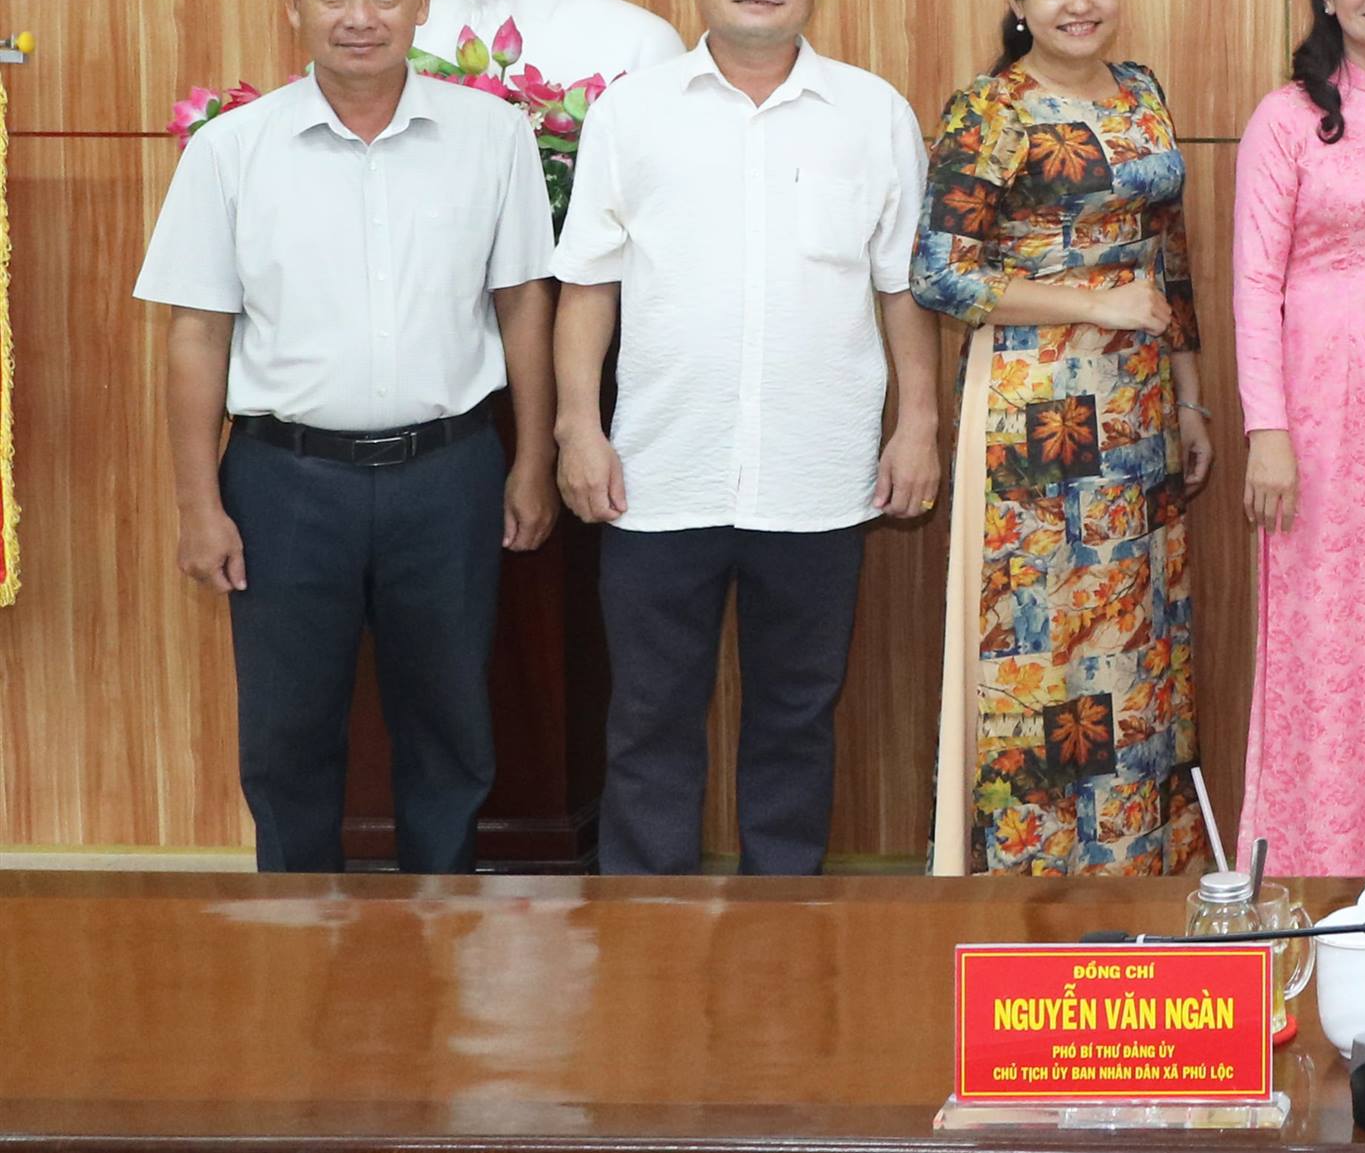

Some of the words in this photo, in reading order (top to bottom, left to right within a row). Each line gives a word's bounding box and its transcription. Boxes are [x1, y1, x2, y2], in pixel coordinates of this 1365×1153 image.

[1126, 962, 1155, 979] CHÍ
[994, 983, 1097, 1031] NGUYỄN
[1105, 991, 1157, 1030] VĂN
[1165, 989, 1234, 1030] NGÀN
[1052, 1042, 1077, 1059] PHÓ
[1080, 1042, 1093, 1059] BÍ
[1096, 1044, 1121, 1059] THƯ
[1123, 1040, 1156, 1059] ĐẢNG
[1158, 1040, 1175, 1059] ỦY
[993, 1063, 1018, 1081] CHỦ
[1020, 1066, 1049, 1083] TỊCH
[1052, 1063, 1069, 1080] ỦY
[1072, 1066, 1096, 1080] BAN
[1099, 1064, 1132, 1080] NHÂN
[1135, 1064, 1160, 1080] DÂN
[1163, 1063, 1179, 1080] XÃ
[1182, 1063, 1207, 1080] PHÚ
[1210, 1062, 1234, 1081] LỘC
